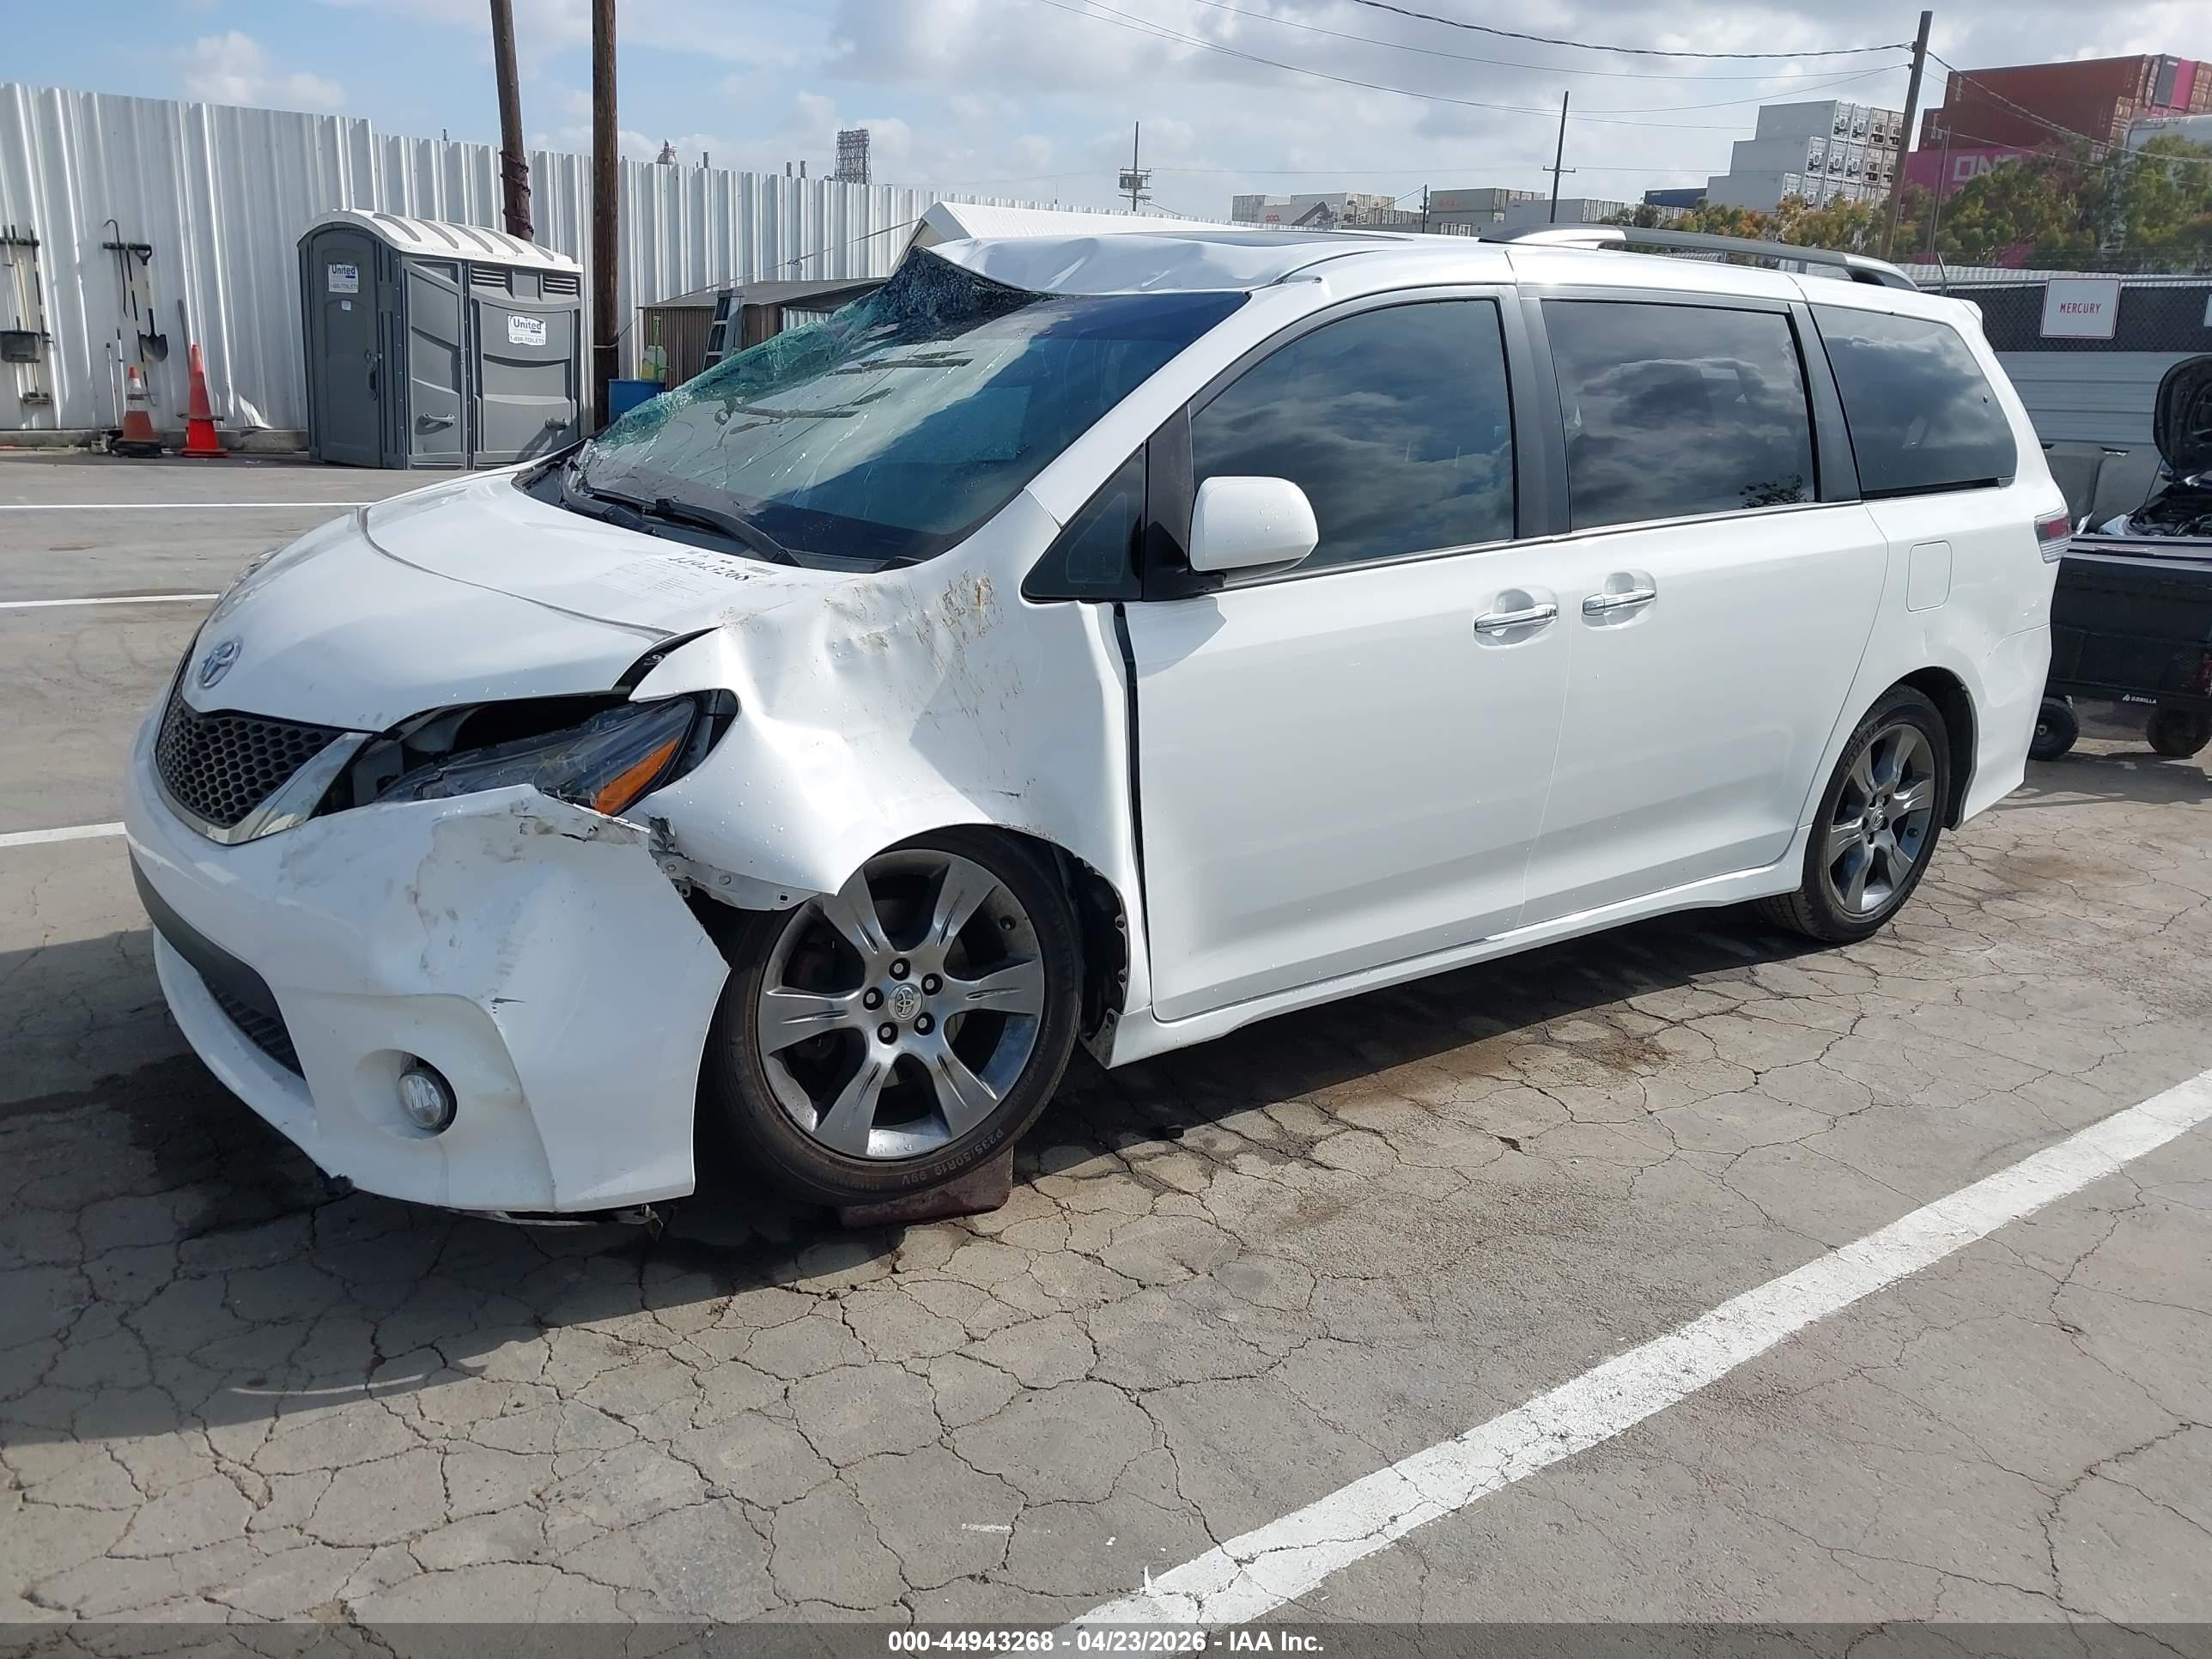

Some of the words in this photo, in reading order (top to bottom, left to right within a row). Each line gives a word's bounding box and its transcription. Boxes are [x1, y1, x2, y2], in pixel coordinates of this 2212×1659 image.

[331, 264, 356, 275] United
[2059, 303, 2102, 314] MERCURY
[513, 318, 542, 331] United
[902, 1169, 928, 1186] 99V
